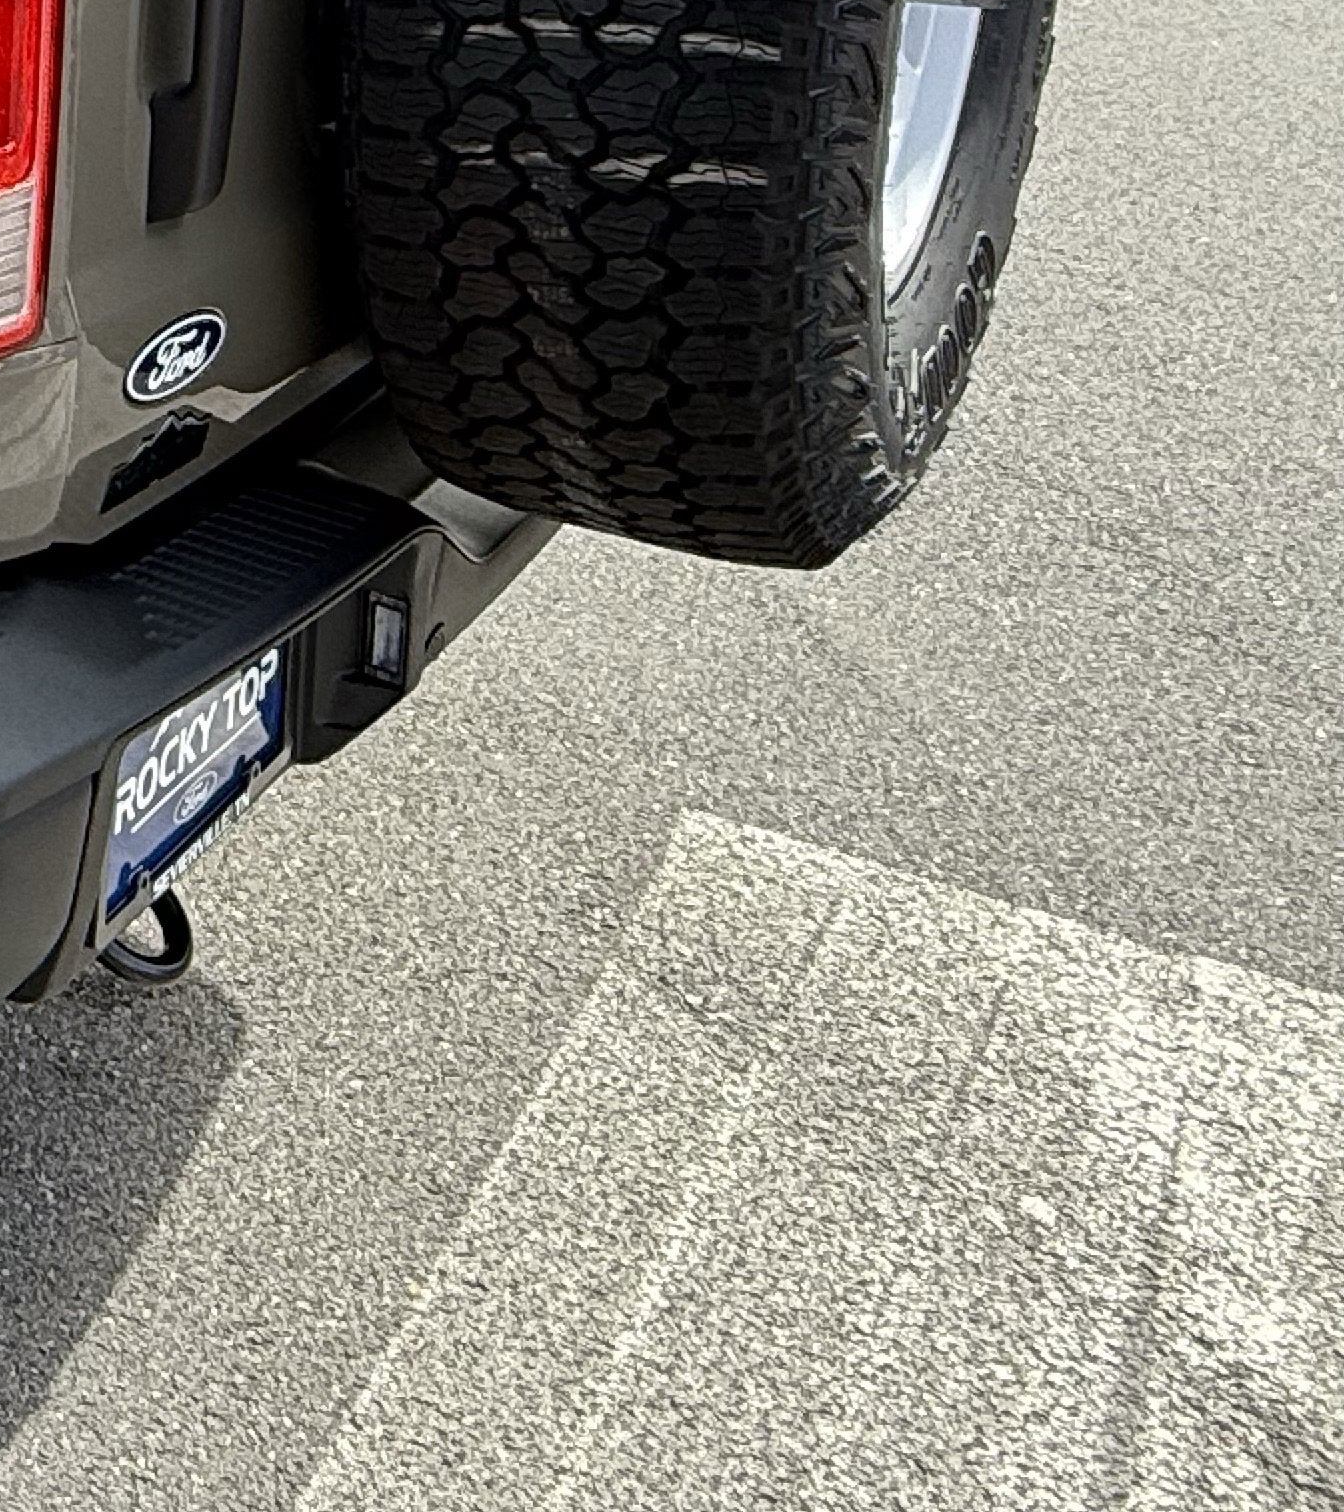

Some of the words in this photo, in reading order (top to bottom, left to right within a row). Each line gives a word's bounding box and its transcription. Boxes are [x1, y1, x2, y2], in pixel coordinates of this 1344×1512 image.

[148, 329, 211, 390] Ford
[115, 700, 217, 835] ROCKY
[223, 648, 278, 730] TOP
